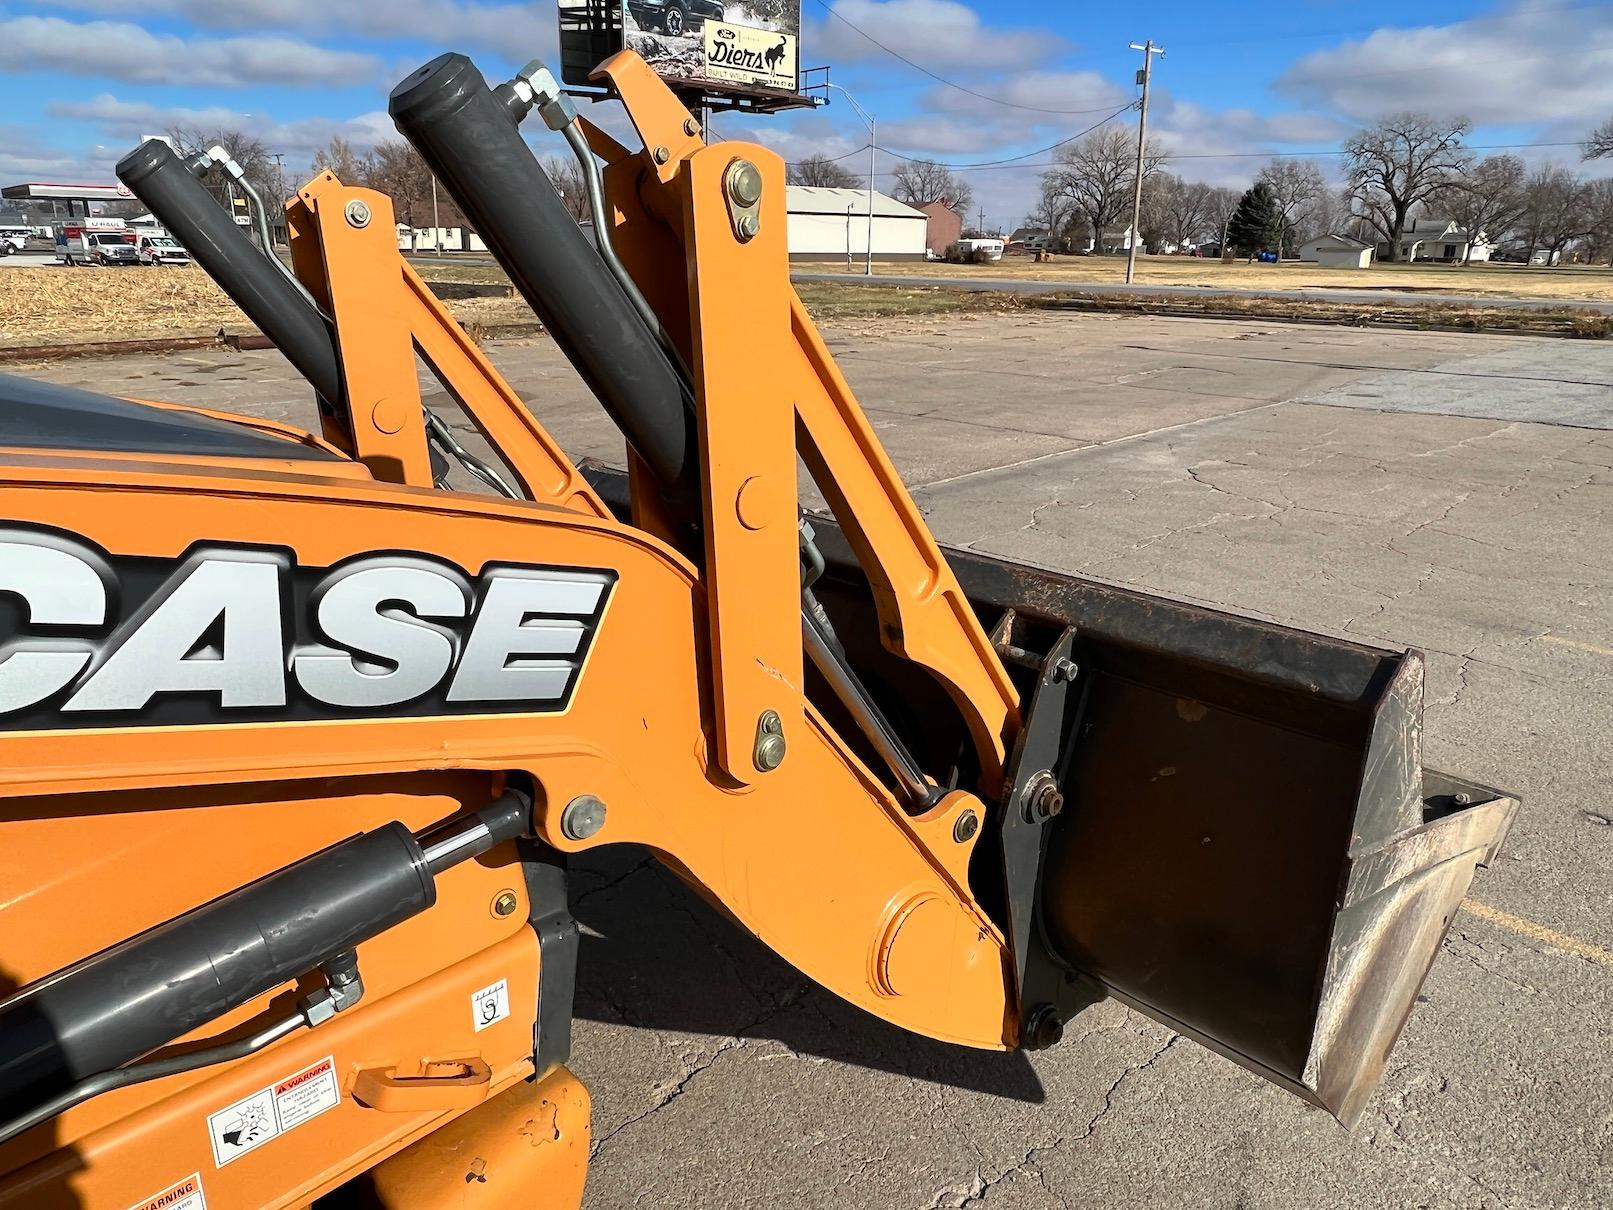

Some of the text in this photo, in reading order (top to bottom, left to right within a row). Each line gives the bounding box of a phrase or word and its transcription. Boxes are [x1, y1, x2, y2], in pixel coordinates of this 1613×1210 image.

[708, 40, 764, 70] Diers
[708, 69, 728, 78] BUILT
[730, 72, 748, 81] WILD
[0, 542, 604, 714] CASE
[288, 1063, 330, 1089] WARNING
